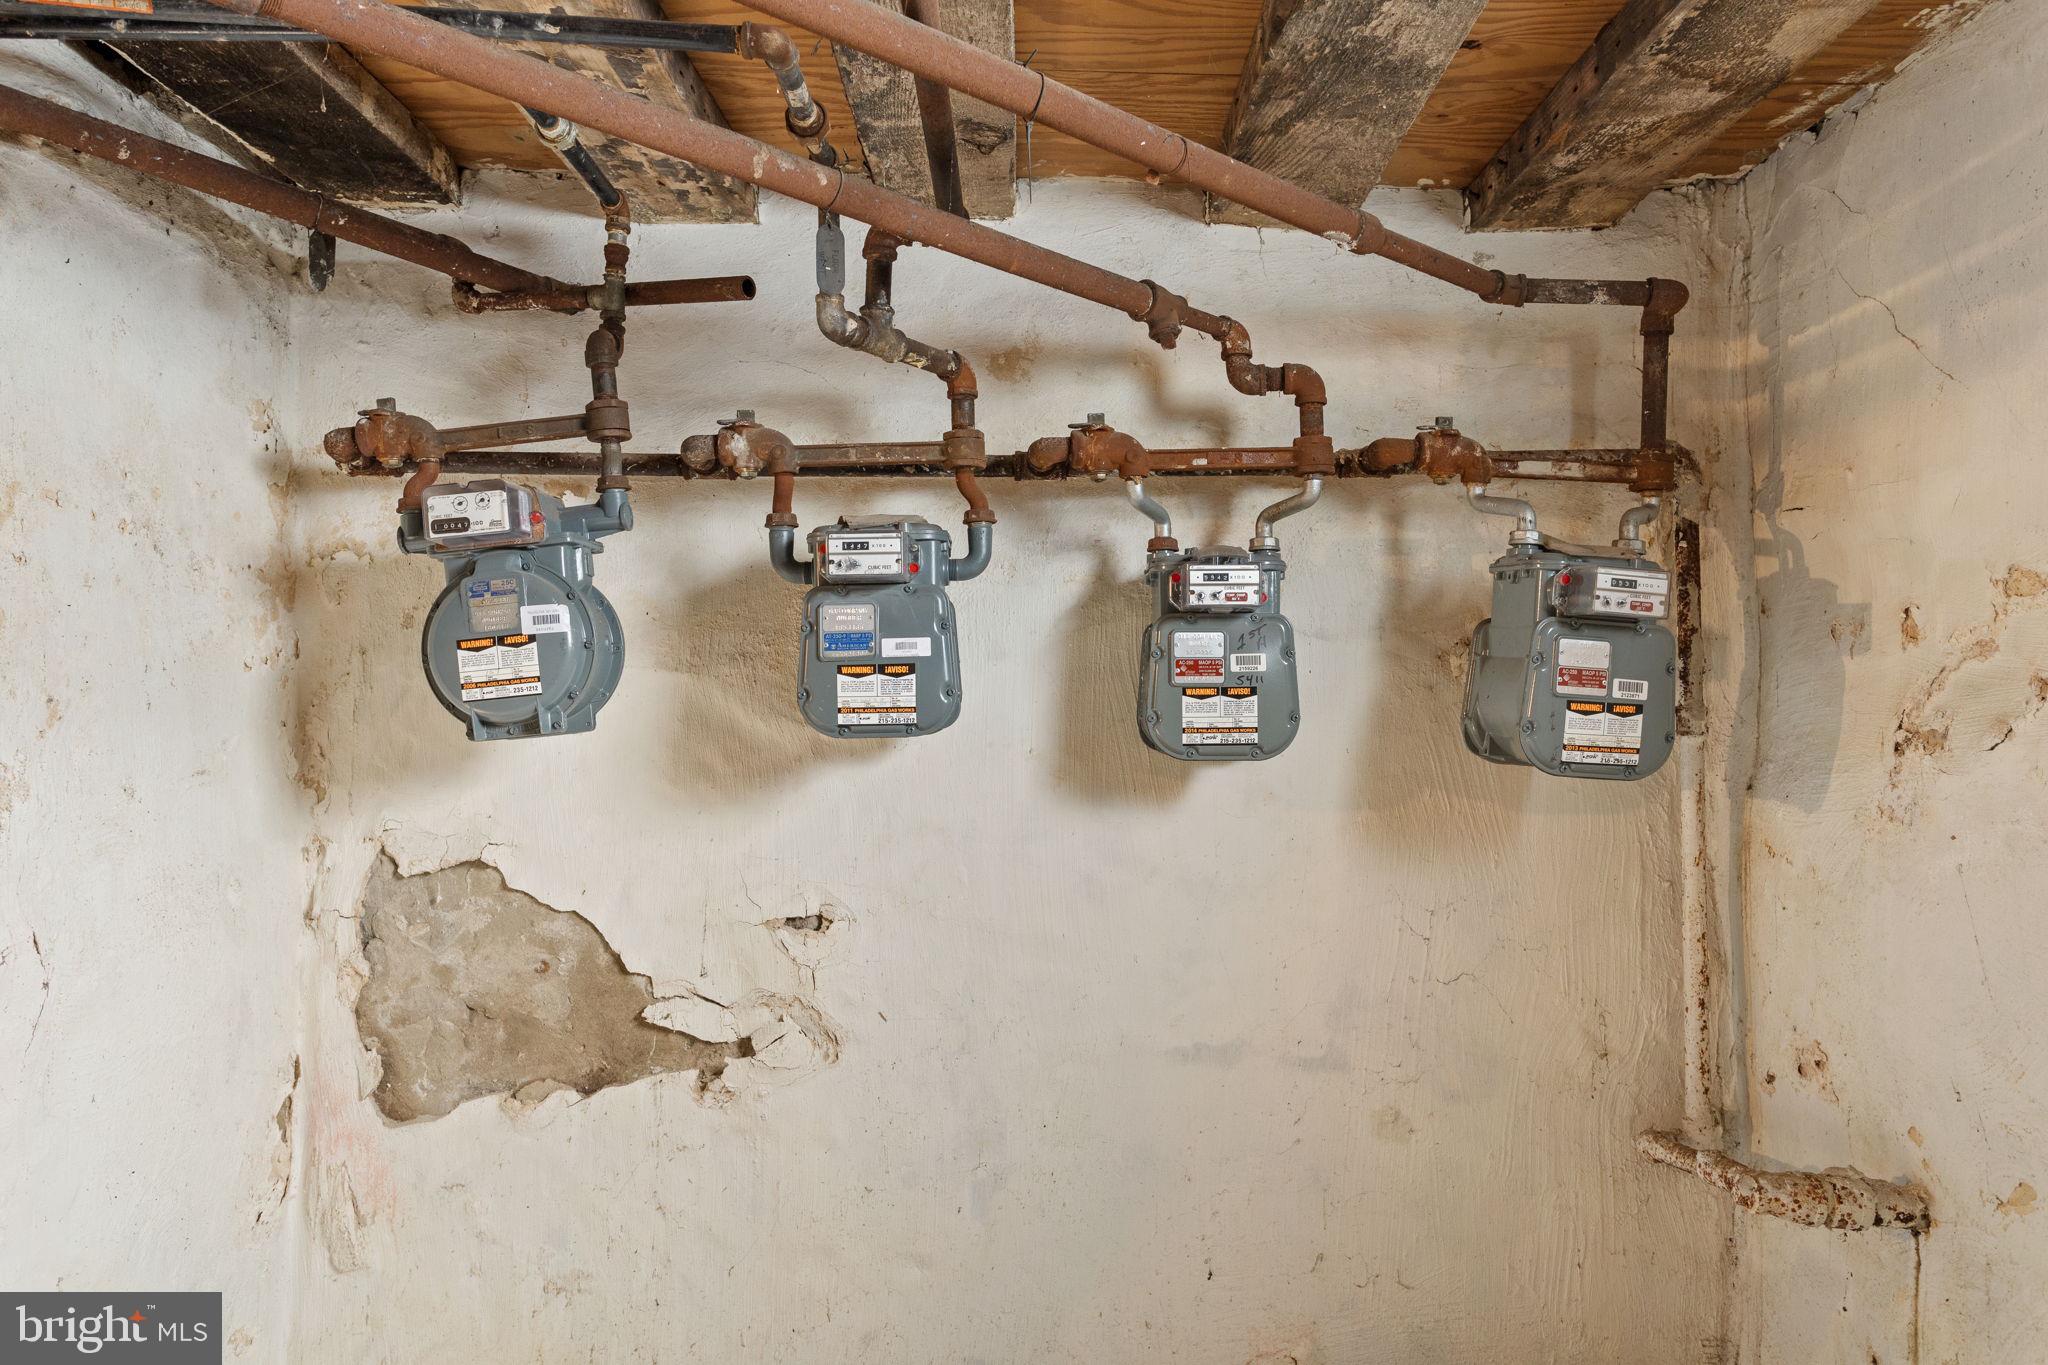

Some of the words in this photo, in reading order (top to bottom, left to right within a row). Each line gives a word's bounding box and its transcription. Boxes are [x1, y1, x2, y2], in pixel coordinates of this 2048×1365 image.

[460, 638, 494, 649] WARNING!
[504, 634, 529, 645] ¡AVISO!
[841, 666, 874, 674] WARNING!
[884, 665, 909, 673] ¡AVISO!
[477, 680, 511, 688] PHILADELPHIA
[512, 685, 539, 694] 235-1212
[1185, 688, 1218, 696] WARNING!
[1227, 687, 1251, 695] ¡AVISO!
[1570, 702, 1603, 712] WARNING!
[1613, 705, 1636, 713] ¡AVISO!
